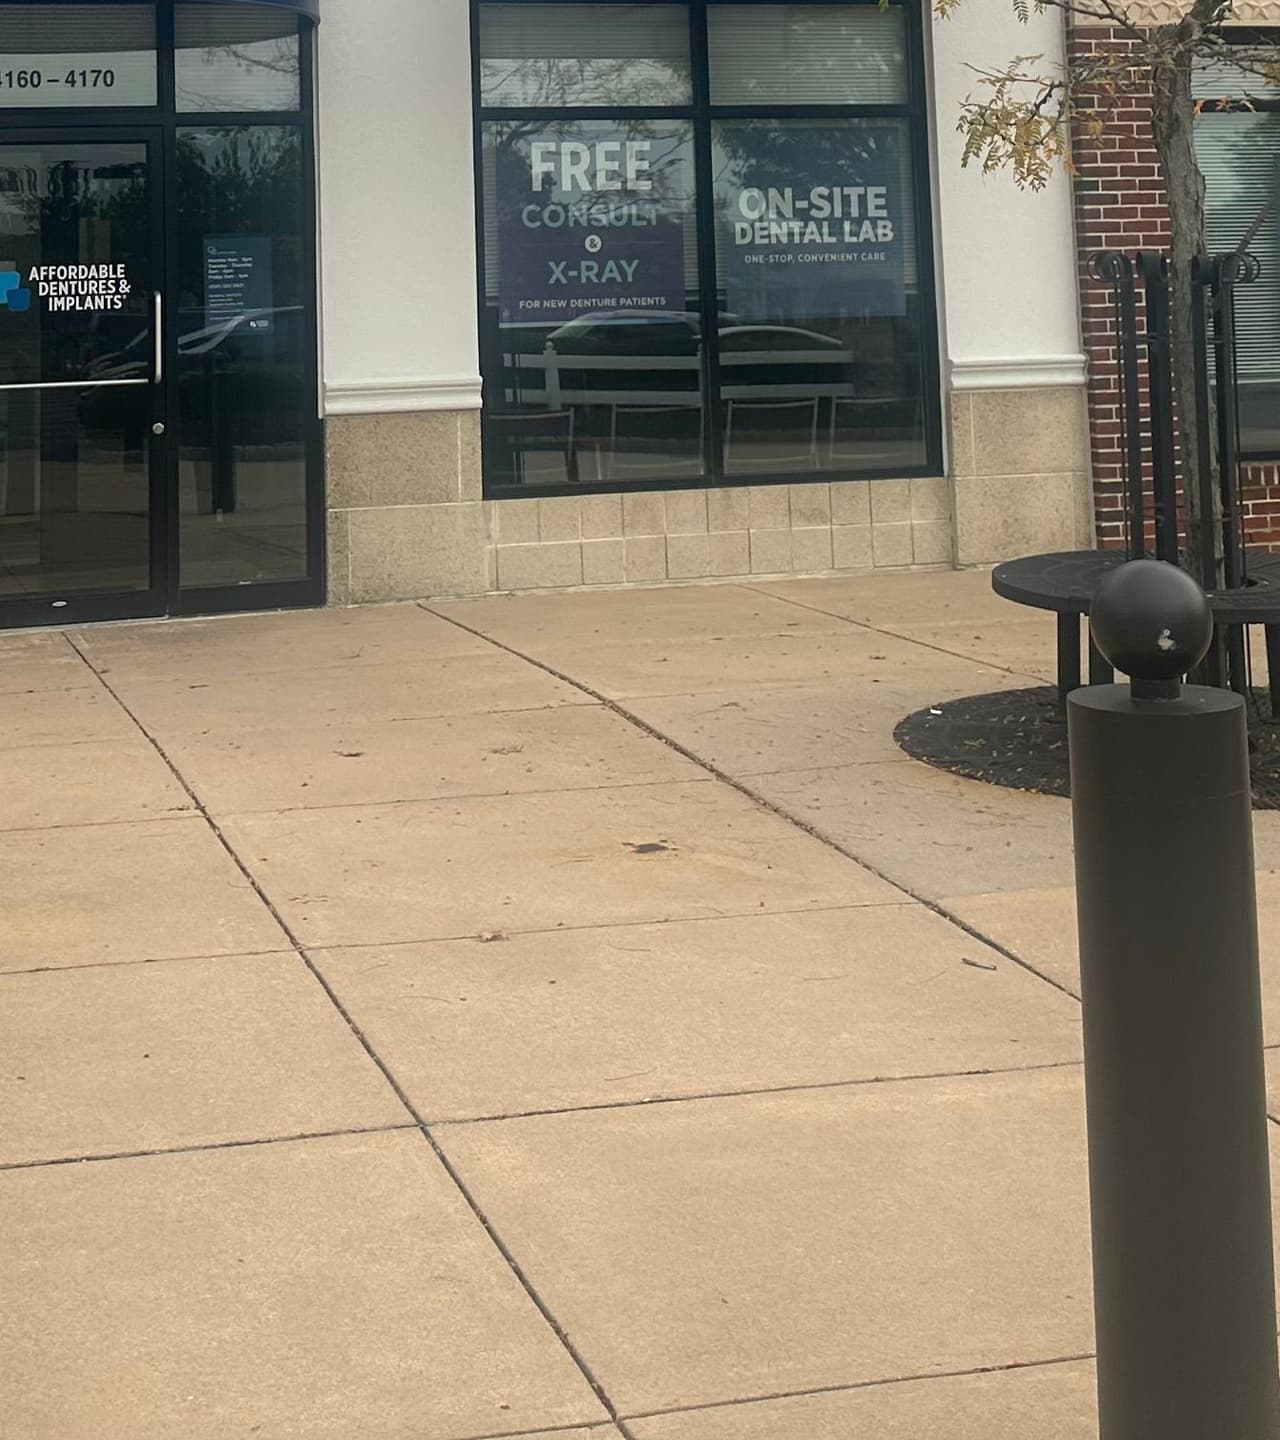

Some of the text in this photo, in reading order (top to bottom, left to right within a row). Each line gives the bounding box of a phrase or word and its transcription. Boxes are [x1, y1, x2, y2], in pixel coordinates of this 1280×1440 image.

[65, 69, 115, 88] 4170
[531, 140, 653, 192] FREE
[738, 185, 888, 220] ON-SITE
[521, 203, 658, 229] CONSULT
[734, 219, 895, 246] DENTAL LAB
[589, 237, 599, 250] &
[797, 253, 858, 263] CONVENIENT
[860, 252, 886, 261] CARE
[28, 263, 126, 281] AFFORDABLE
[548, 259, 640, 285] X-RAY
[38, 278, 132, 297] DENTURES &
[519, 296, 667, 310] FOR NEW DENTURE PATIENTS
